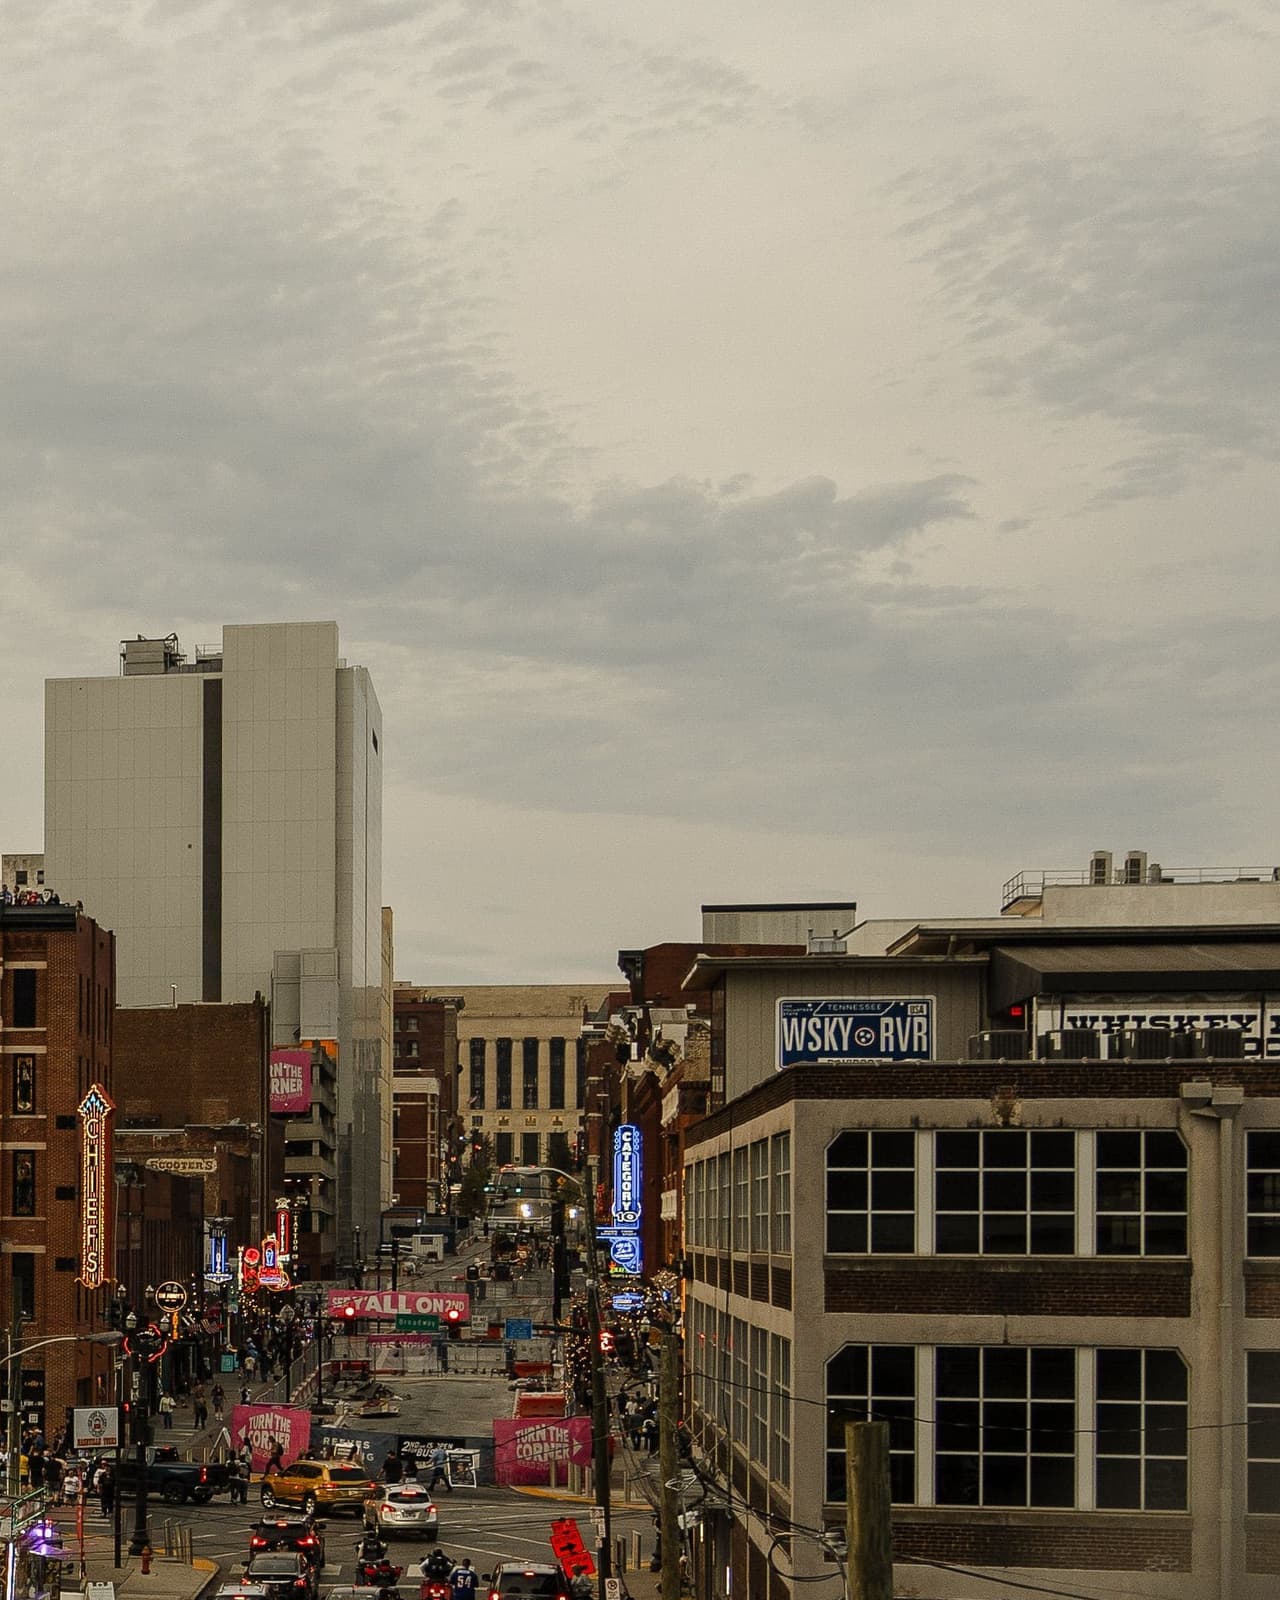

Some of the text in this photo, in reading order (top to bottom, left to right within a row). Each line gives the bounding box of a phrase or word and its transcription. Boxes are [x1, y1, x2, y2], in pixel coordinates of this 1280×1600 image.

[827, 1003, 882, 1011] TENNESSEE
[782, 1016, 928, 1052] WSKY RVR
[285, 1063, 303, 1078] THE
[621, 1131, 632, 1211] CATEGORY
[617, 1212, 637, 1222] 10
[353, 1294, 412, 1314] Y'ALL
[415, 1296, 446, 1314] ON
[445, 1300, 465, 1312] 2ND
[398, 1317, 436, 1328] Broadway
[249, 1412, 291, 1430] TURN THE
[515, 1425, 569, 1443] TURN THE
[516, 1443, 570, 1462] CORNER
[457, 1575, 472, 1588] 54
